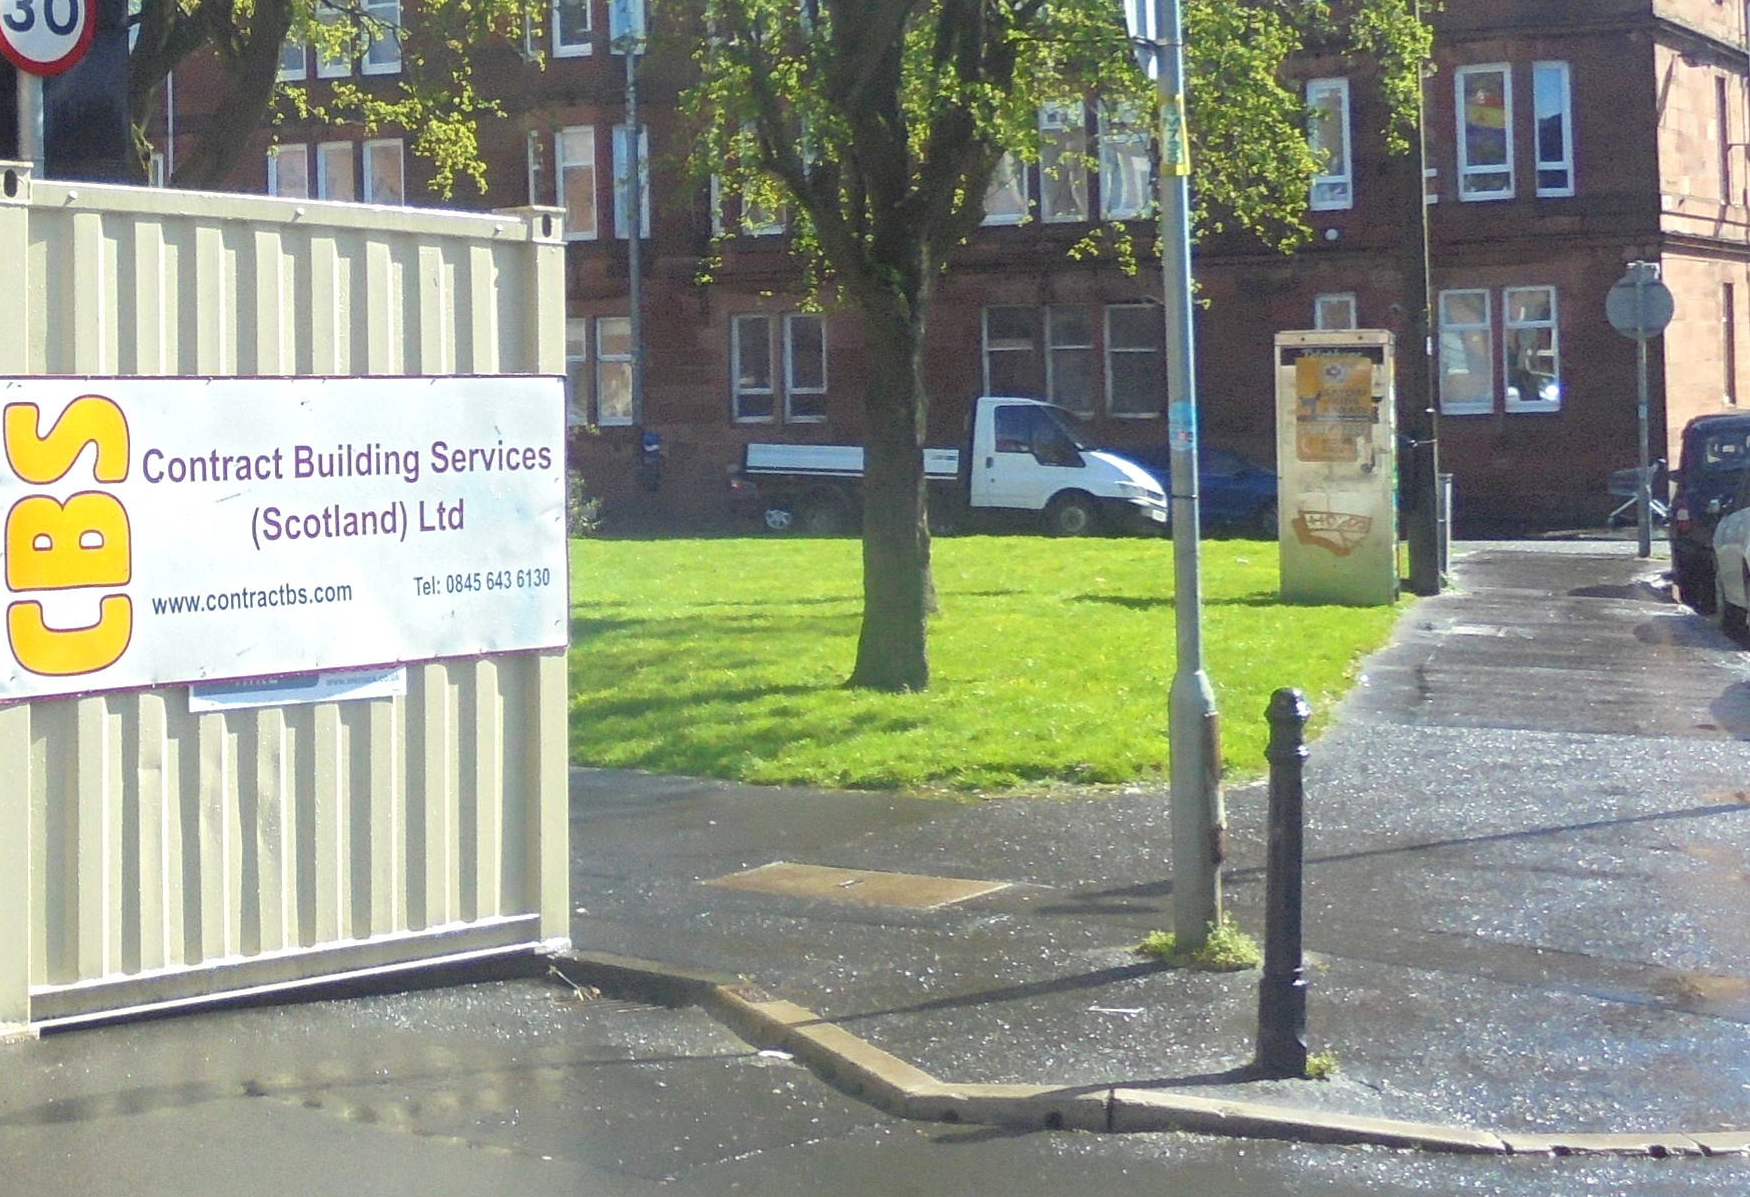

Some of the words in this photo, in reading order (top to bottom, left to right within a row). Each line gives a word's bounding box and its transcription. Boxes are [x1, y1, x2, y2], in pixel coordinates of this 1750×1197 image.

[143, 447, 284, 484] Contract
[294, 443, 420, 483] Building
[431, 440, 551, 474] Services
[3, 394, 133, 677] CBS
[251, 501, 408, 551] (Scotland)
[419, 498, 465, 532] Ltd
[152, 582, 353, 615] www.contractbs.com
[413, 576, 441, 596] Tel:
[446, 572, 482, 593] 0845
[486, 570, 512, 591] 643
[517, 567, 550, 589] 6130
